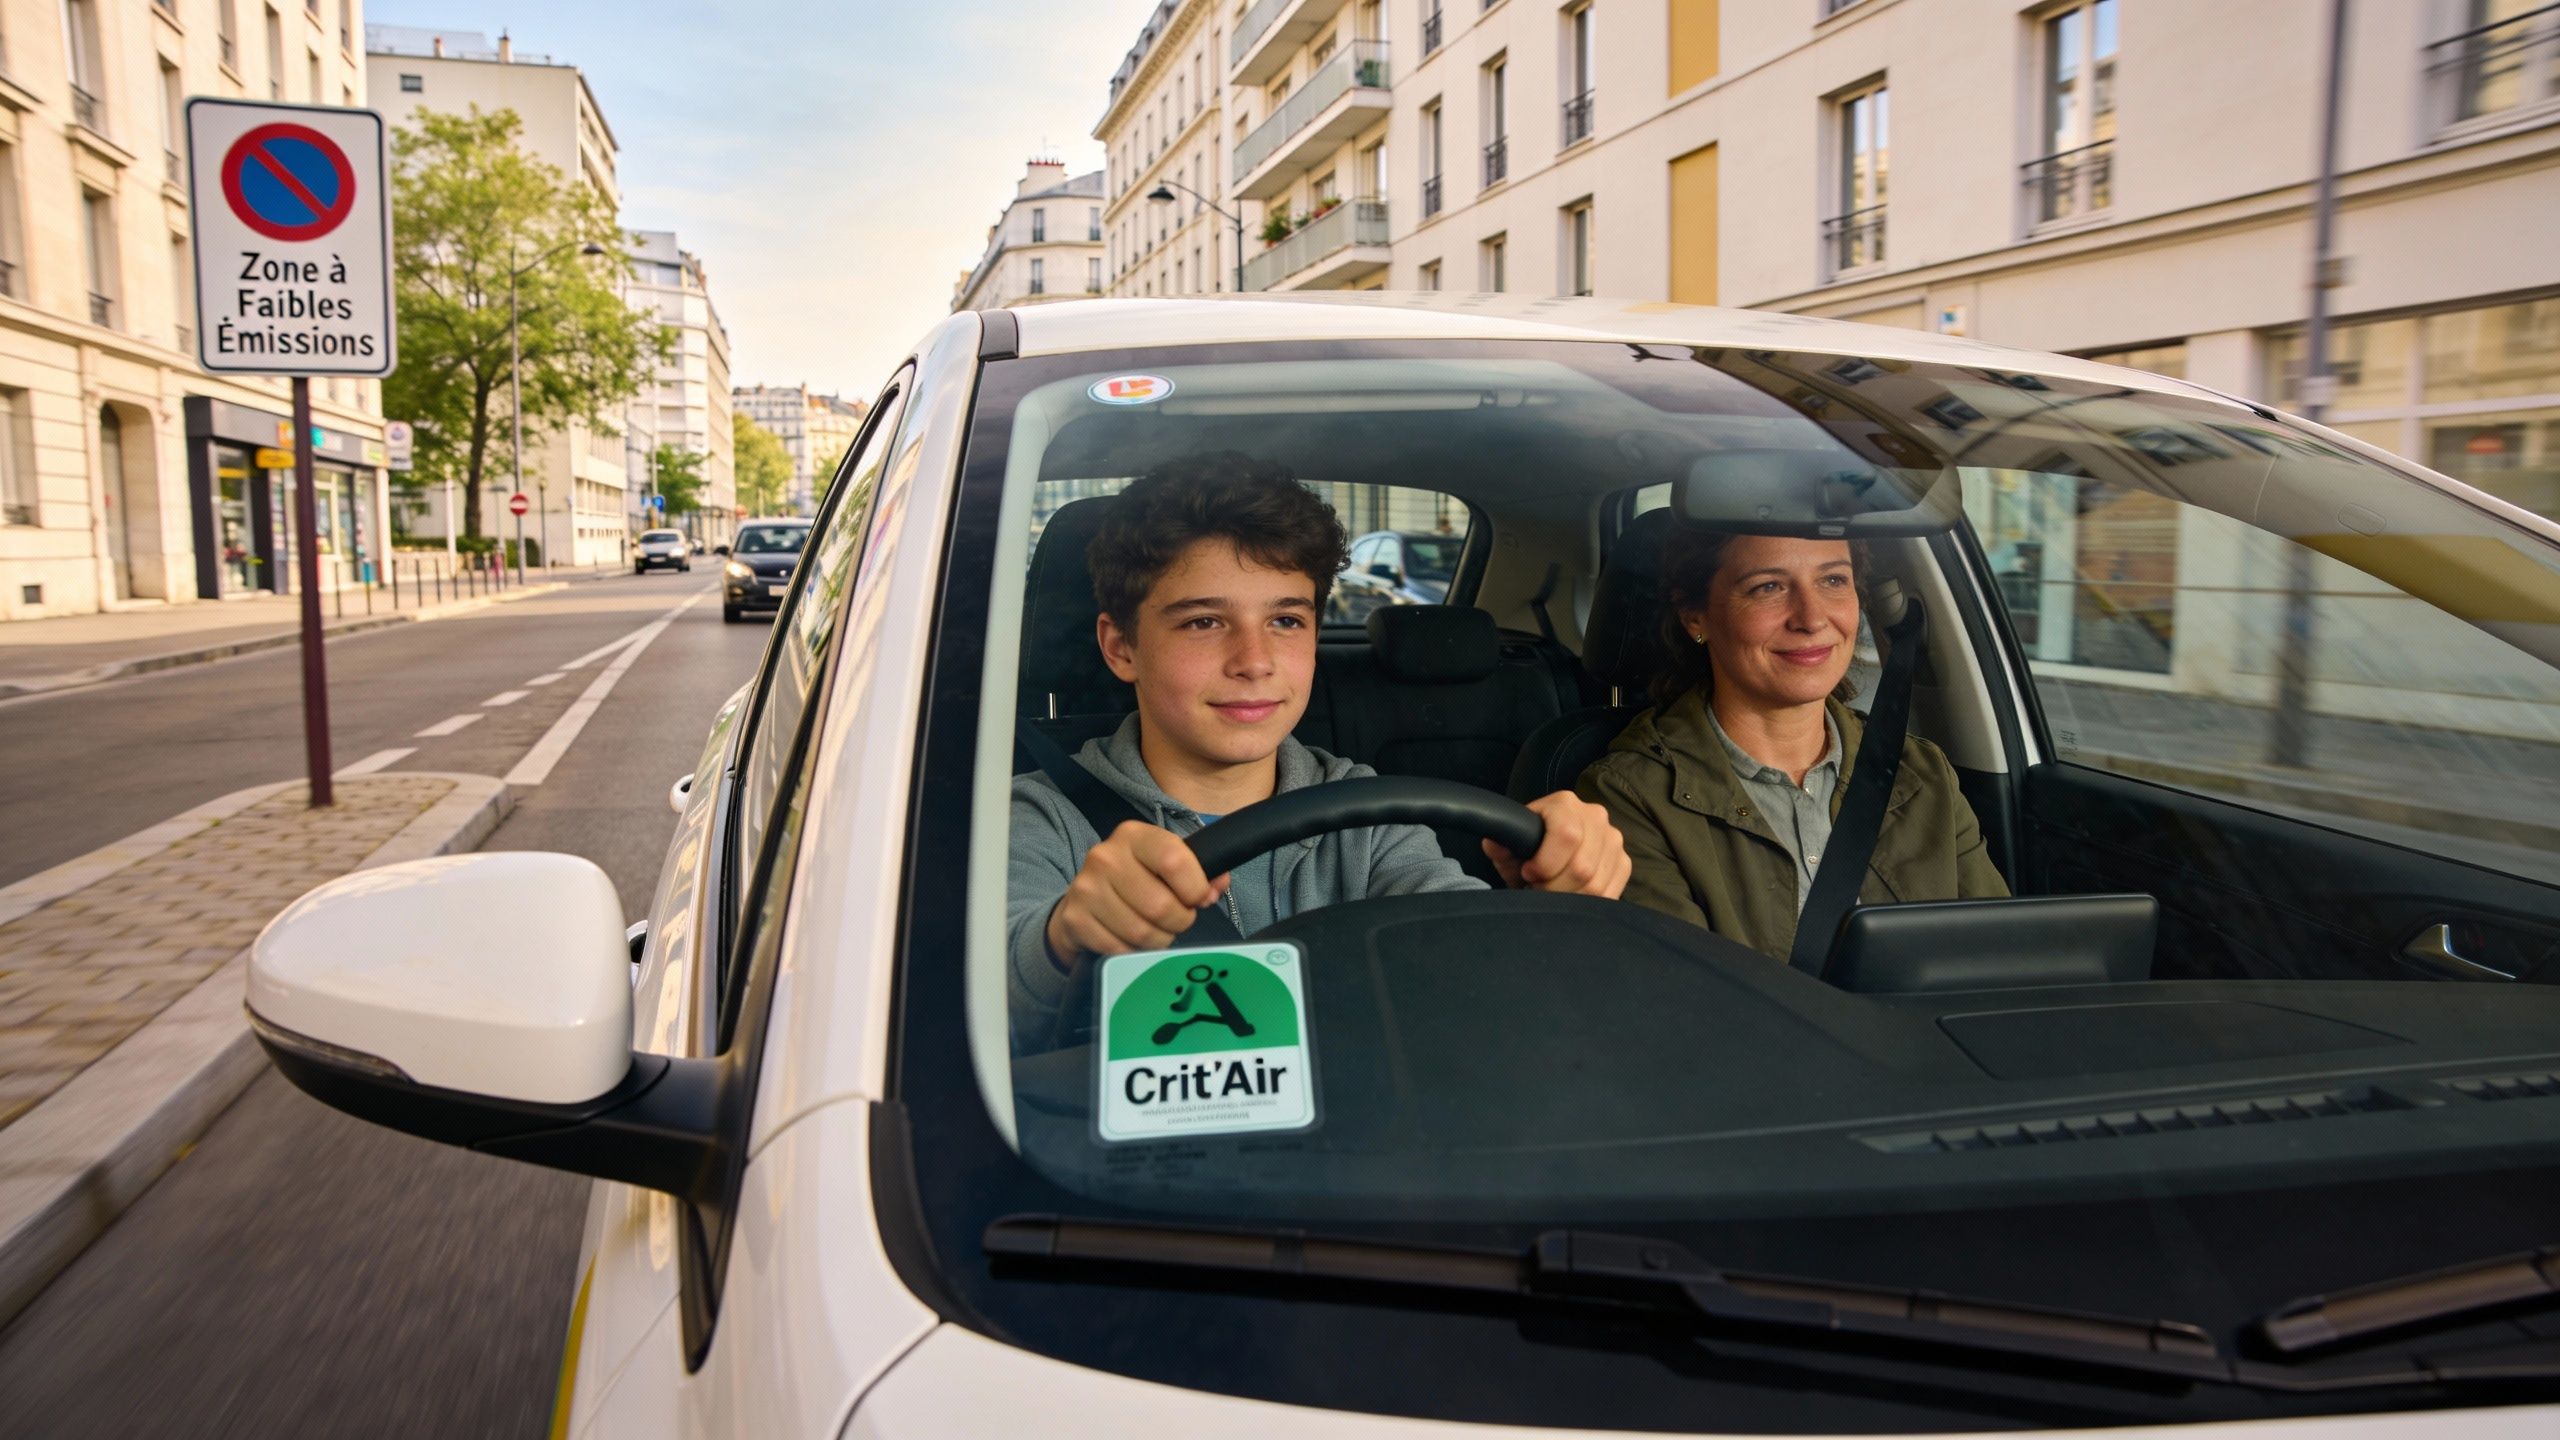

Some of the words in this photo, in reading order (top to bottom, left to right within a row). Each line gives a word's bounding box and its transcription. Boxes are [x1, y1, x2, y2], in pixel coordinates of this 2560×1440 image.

[240, 252, 319, 282] Zone
[329, 254, 347, 284] à
[238, 289, 353, 319] Faibles
[1124, 1057, 1287, 1105] Crit'Air
